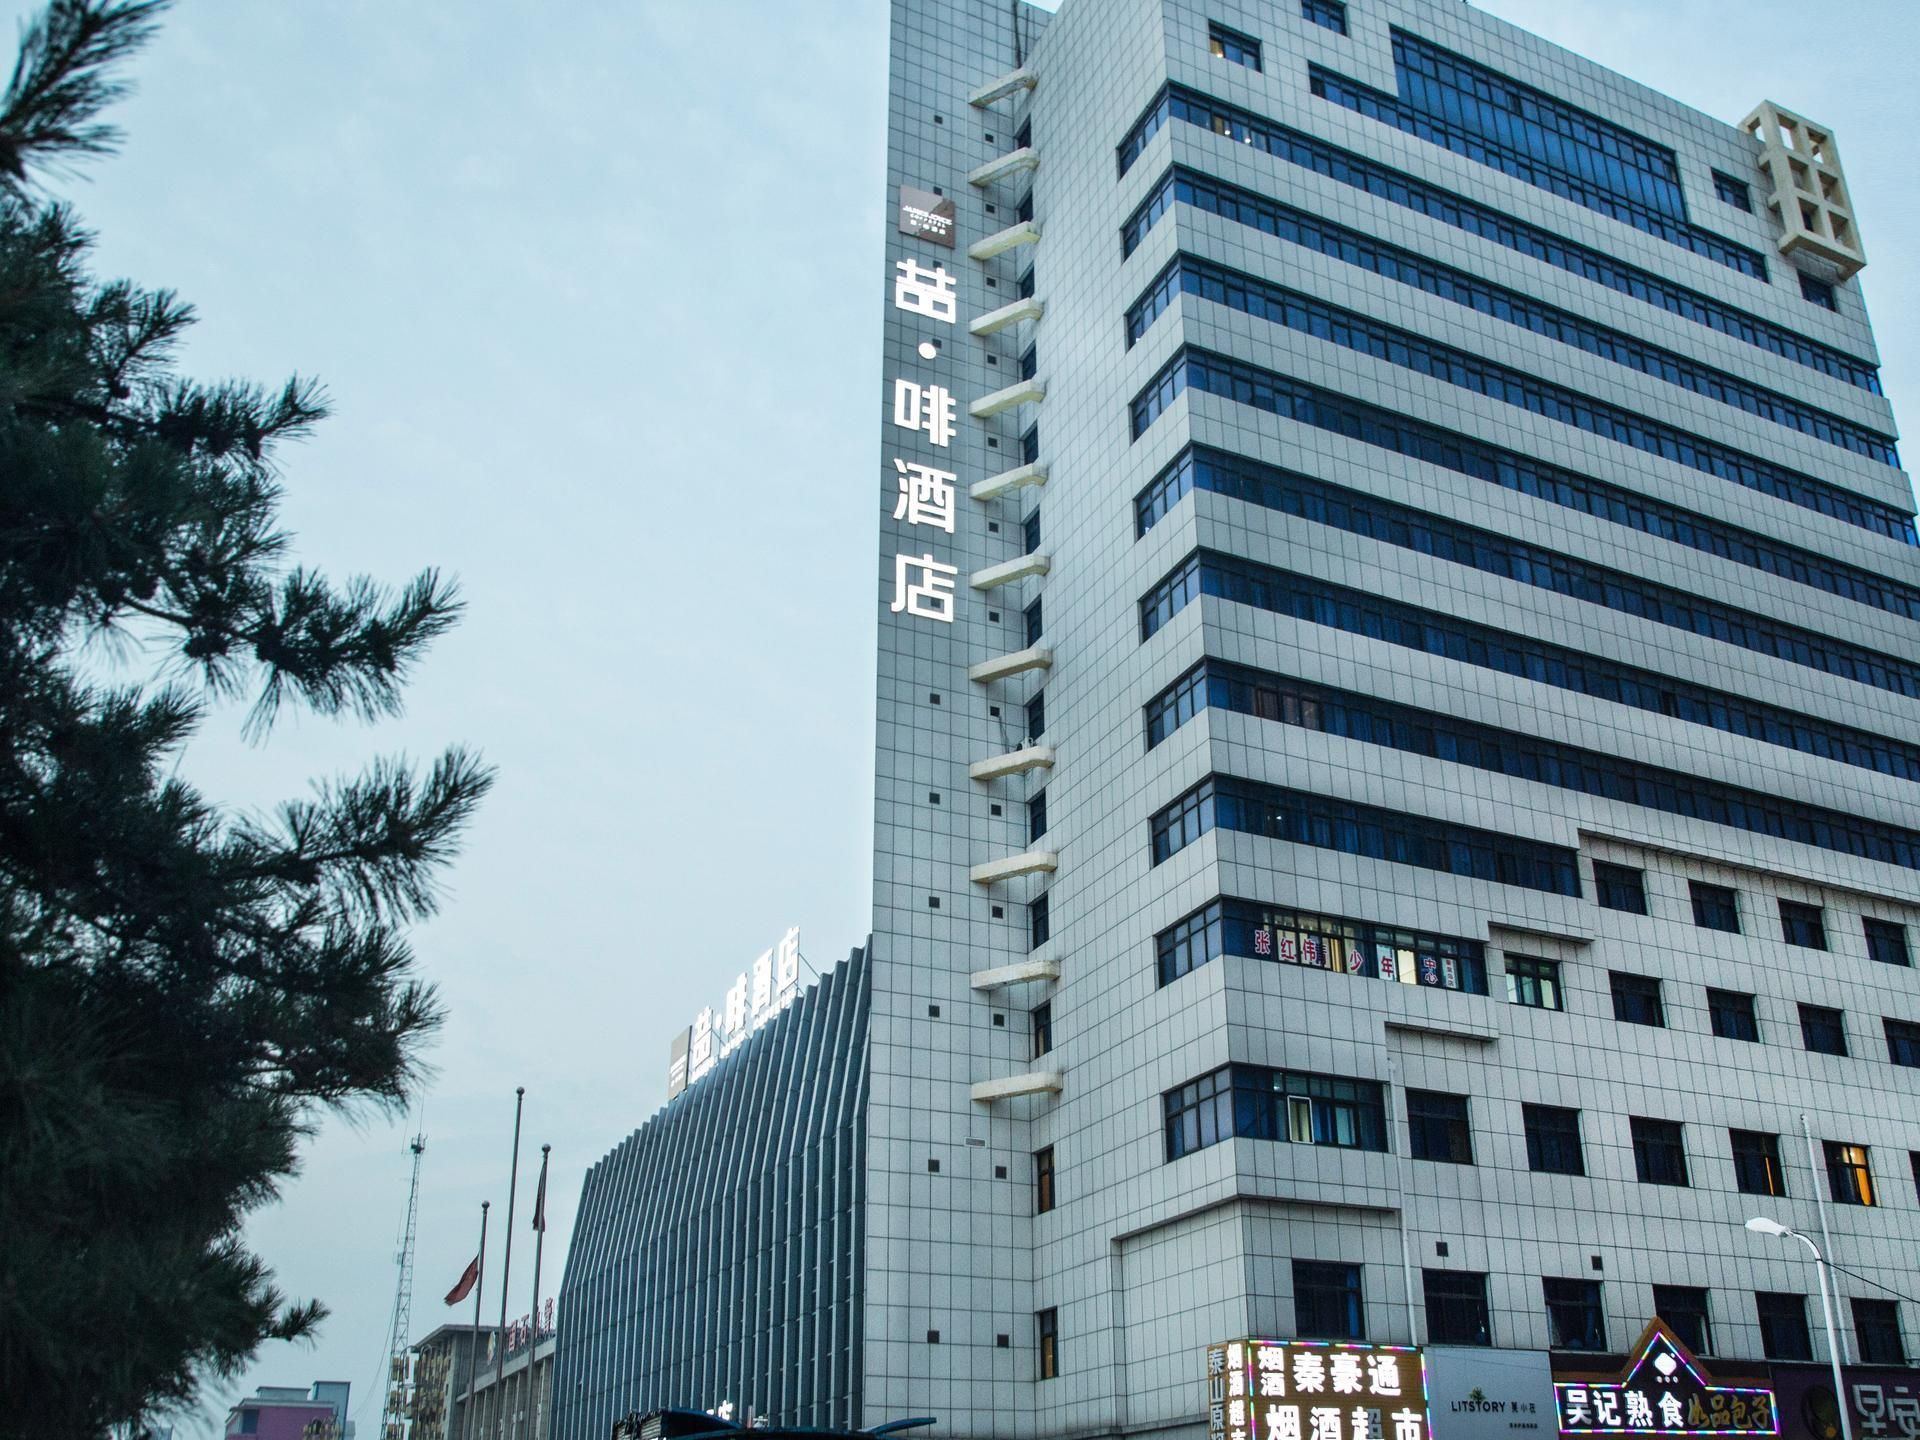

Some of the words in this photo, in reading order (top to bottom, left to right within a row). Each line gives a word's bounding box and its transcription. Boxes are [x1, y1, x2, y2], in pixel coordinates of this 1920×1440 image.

[891, 258, 957, 624] 喆·啡酒店
[1293, 1352, 1401, 1396] 秦豪通
[1451, 1400, 1505, 1412] LITSTORY
[1566, 1390, 1684, 1427] 吴记熟食
